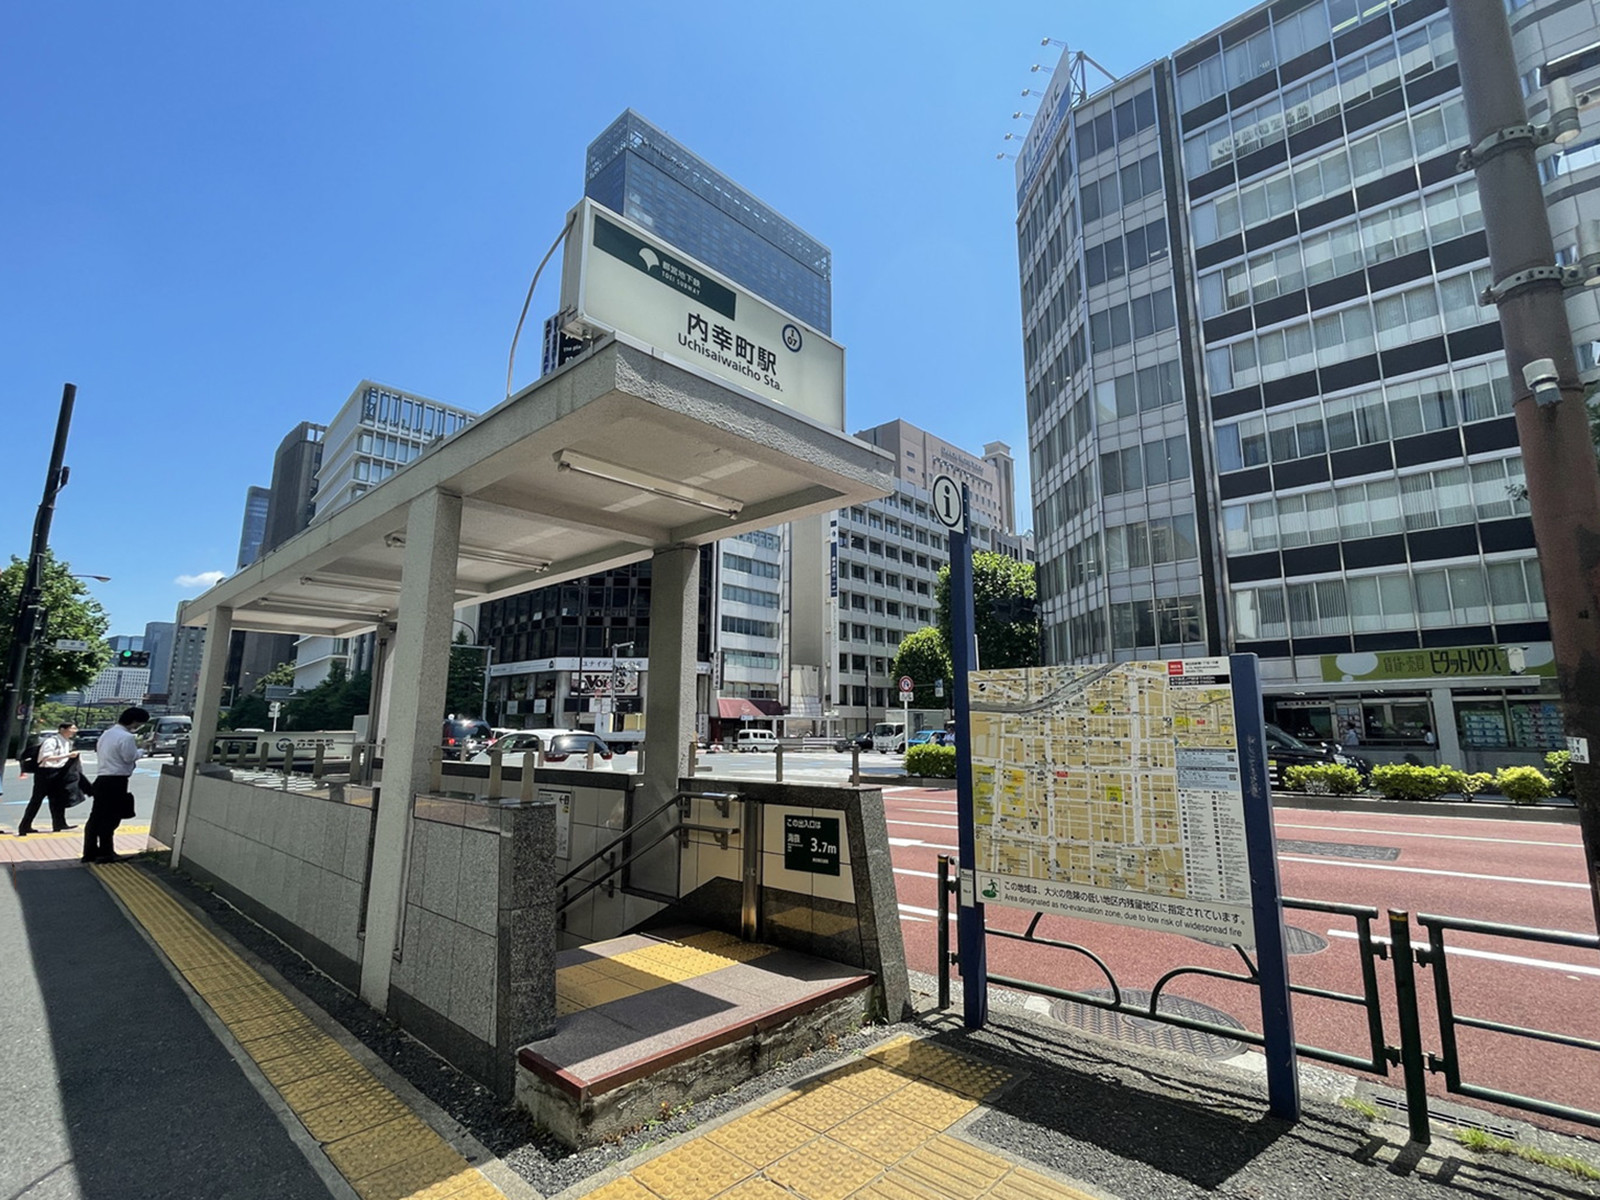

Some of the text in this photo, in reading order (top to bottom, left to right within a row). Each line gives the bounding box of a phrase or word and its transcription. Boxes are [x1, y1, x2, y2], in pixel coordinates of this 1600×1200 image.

[687, 312, 777, 376] 内幸町駅
[787, 336, 798, 347] 07
[678, 332, 783, 392] Uchisaiwaicho Sta.
[1429, 648, 1502, 674] ピタットハウス
[810, 837, 837, 854] 3.7m
[1004, 893, 1017, 902] Area
[1019, 896, 1050, 907] designated
[1060, 903, 1104, 915] no-evacuation
[1105, 909, 1123, 919] zone,
[1124, 912, 1137, 920] due
[1139, 913, 1146, 922] to
[1147, 915, 1159, 924] low
[1161, 918, 1174, 927] risk
[1175, 919, 1182, 928] of
[1184, 921, 1228, 935] widespread
[1229, 927, 1243, 937] fire
